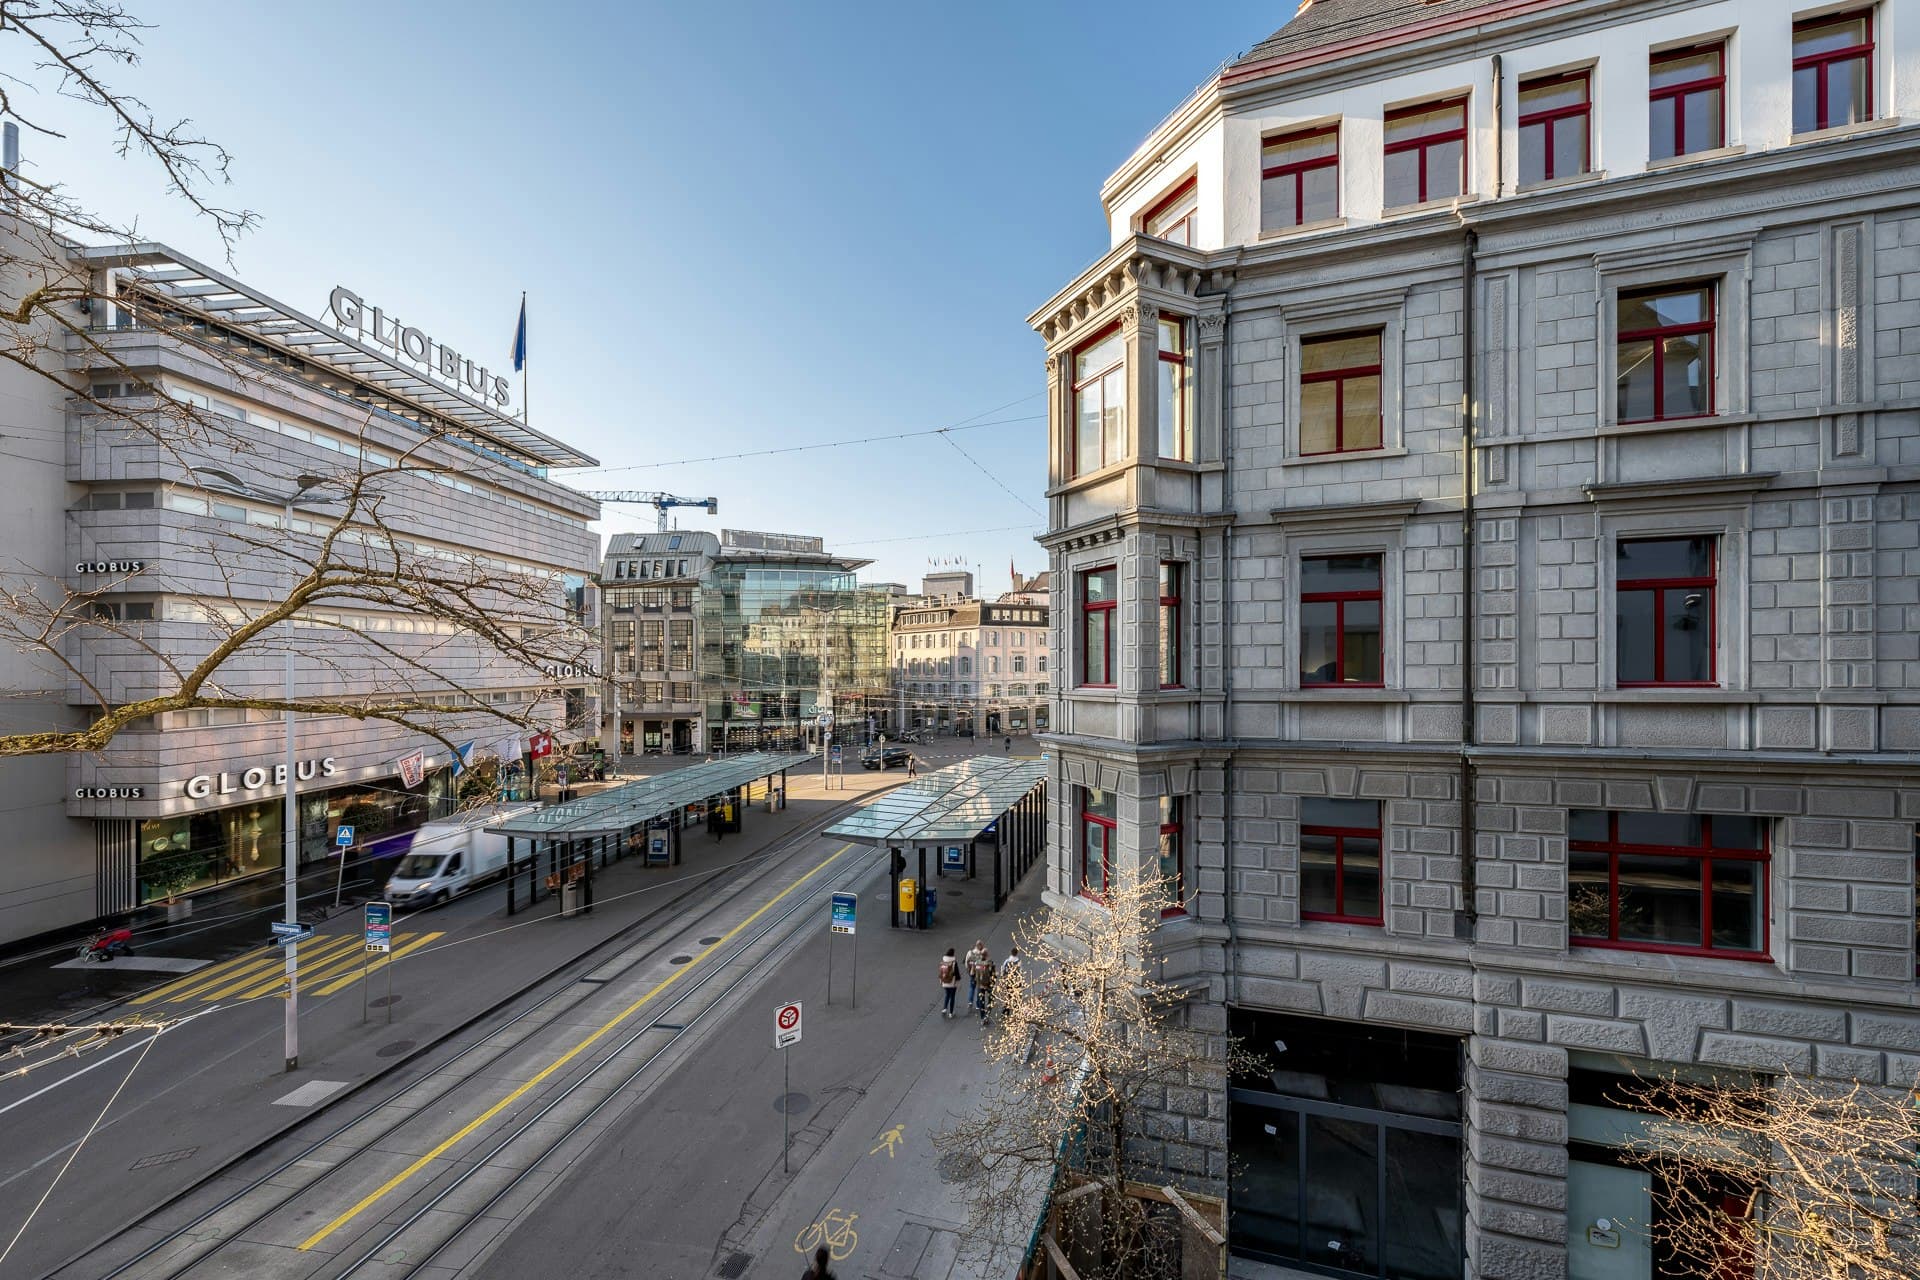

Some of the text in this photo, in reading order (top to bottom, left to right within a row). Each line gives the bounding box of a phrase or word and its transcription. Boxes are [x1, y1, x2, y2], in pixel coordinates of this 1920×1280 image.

[329, 287, 510, 406] GLOBUS
[75, 562, 141, 573] GLOBUS
[186, 757, 336, 799] GLOBUS
[75, 787, 141, 798] GLOBUS
